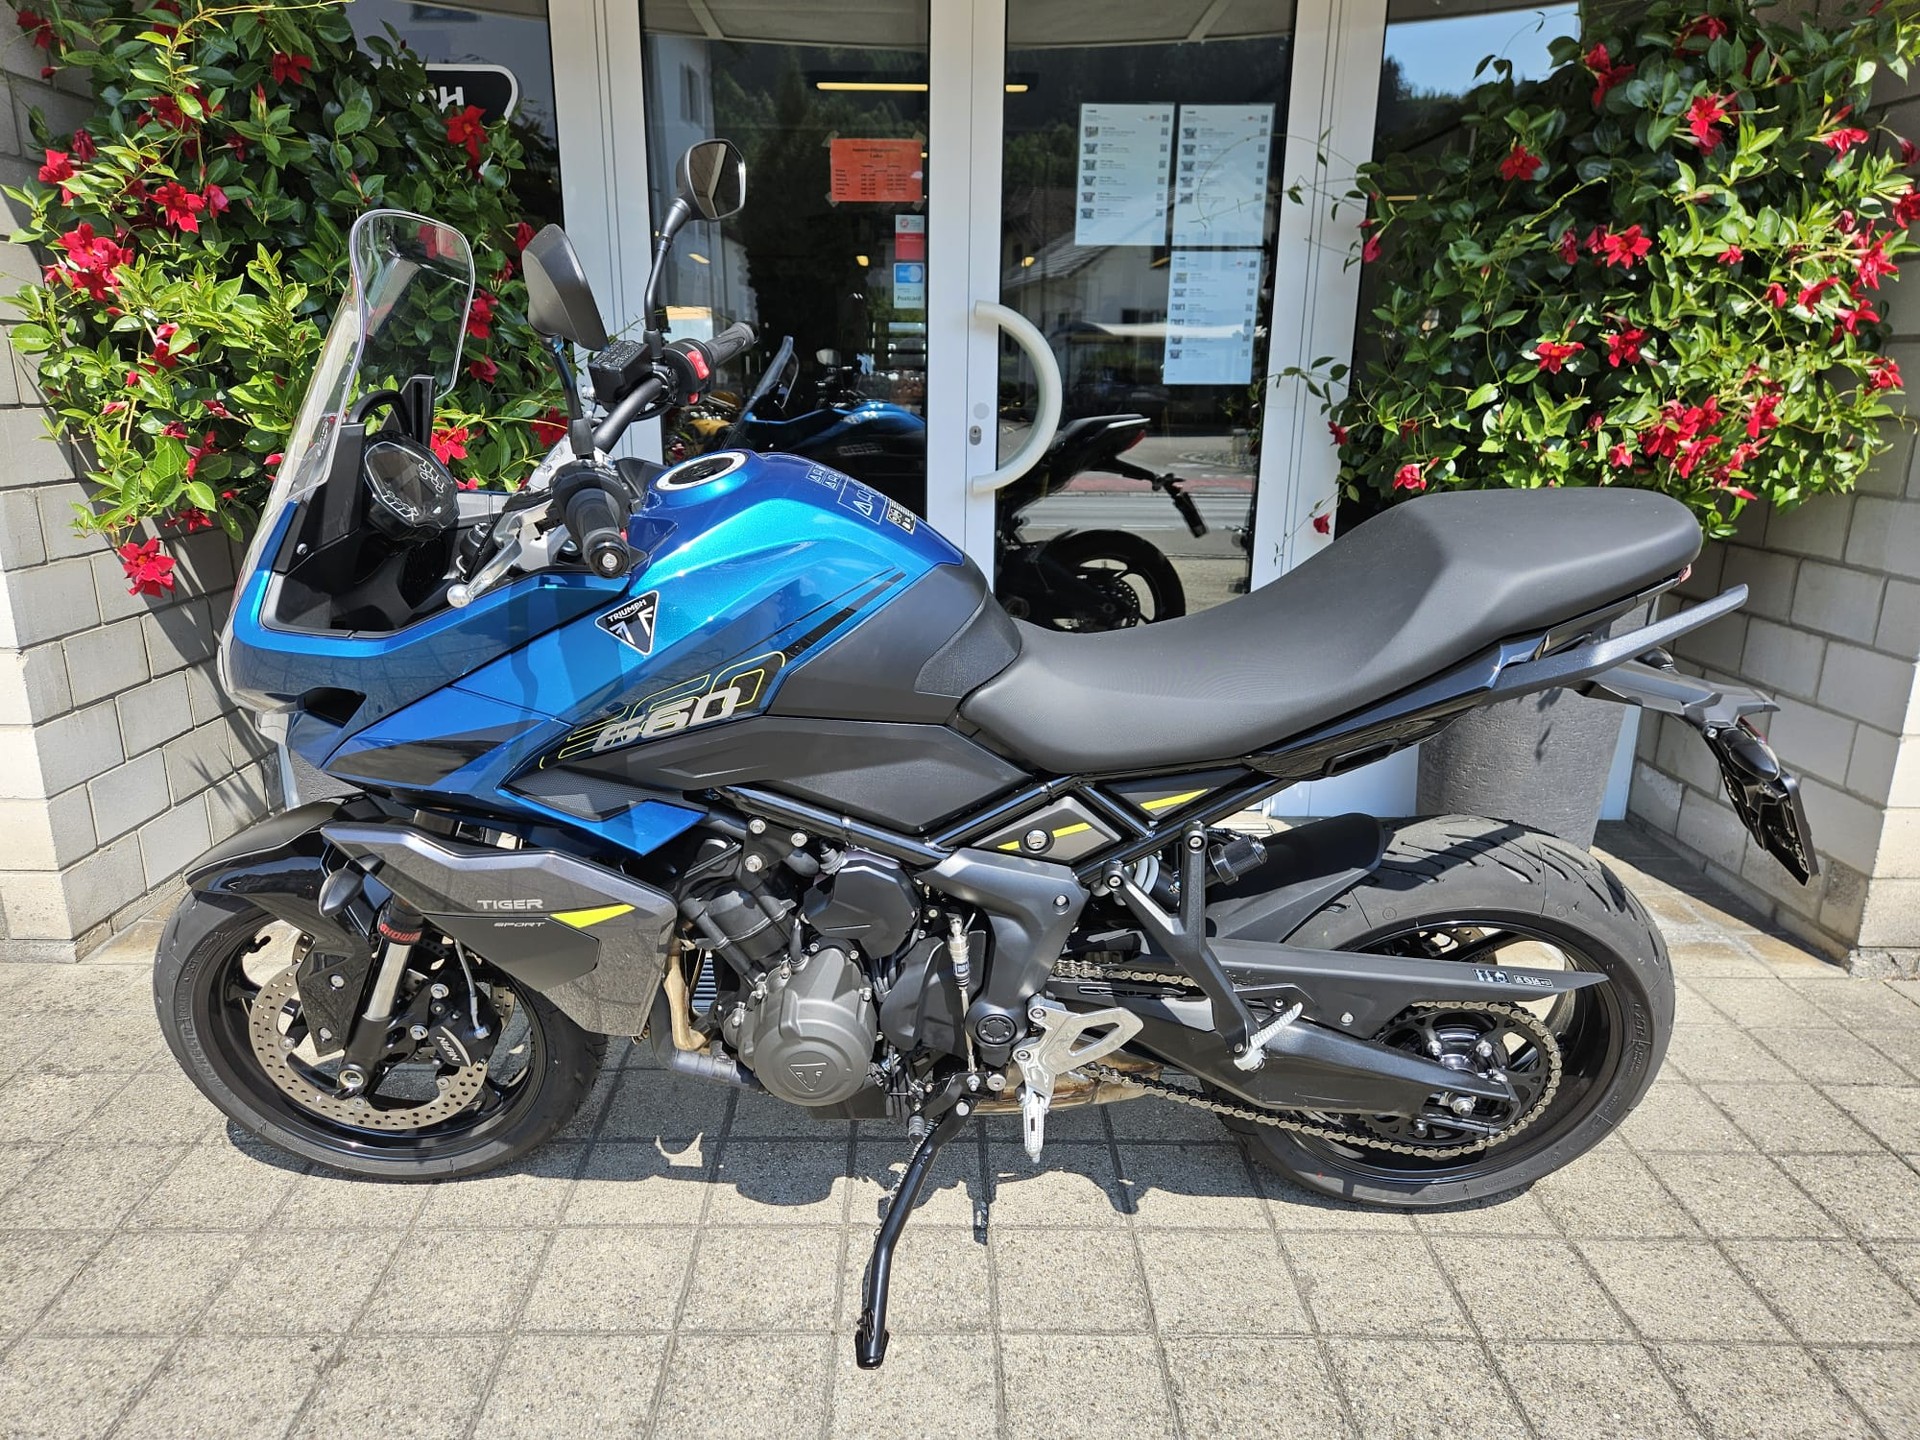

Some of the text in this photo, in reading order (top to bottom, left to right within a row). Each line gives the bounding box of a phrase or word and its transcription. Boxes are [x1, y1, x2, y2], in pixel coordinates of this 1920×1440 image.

[607, 599, 647, 622] TRIUMPH
[592, 686, 741, 752] 660
[477, 899, 544, 910] TIGER
[379, 923, 422, 942] SHOWA
[436, 1036, 461, 1061] NISSIN
